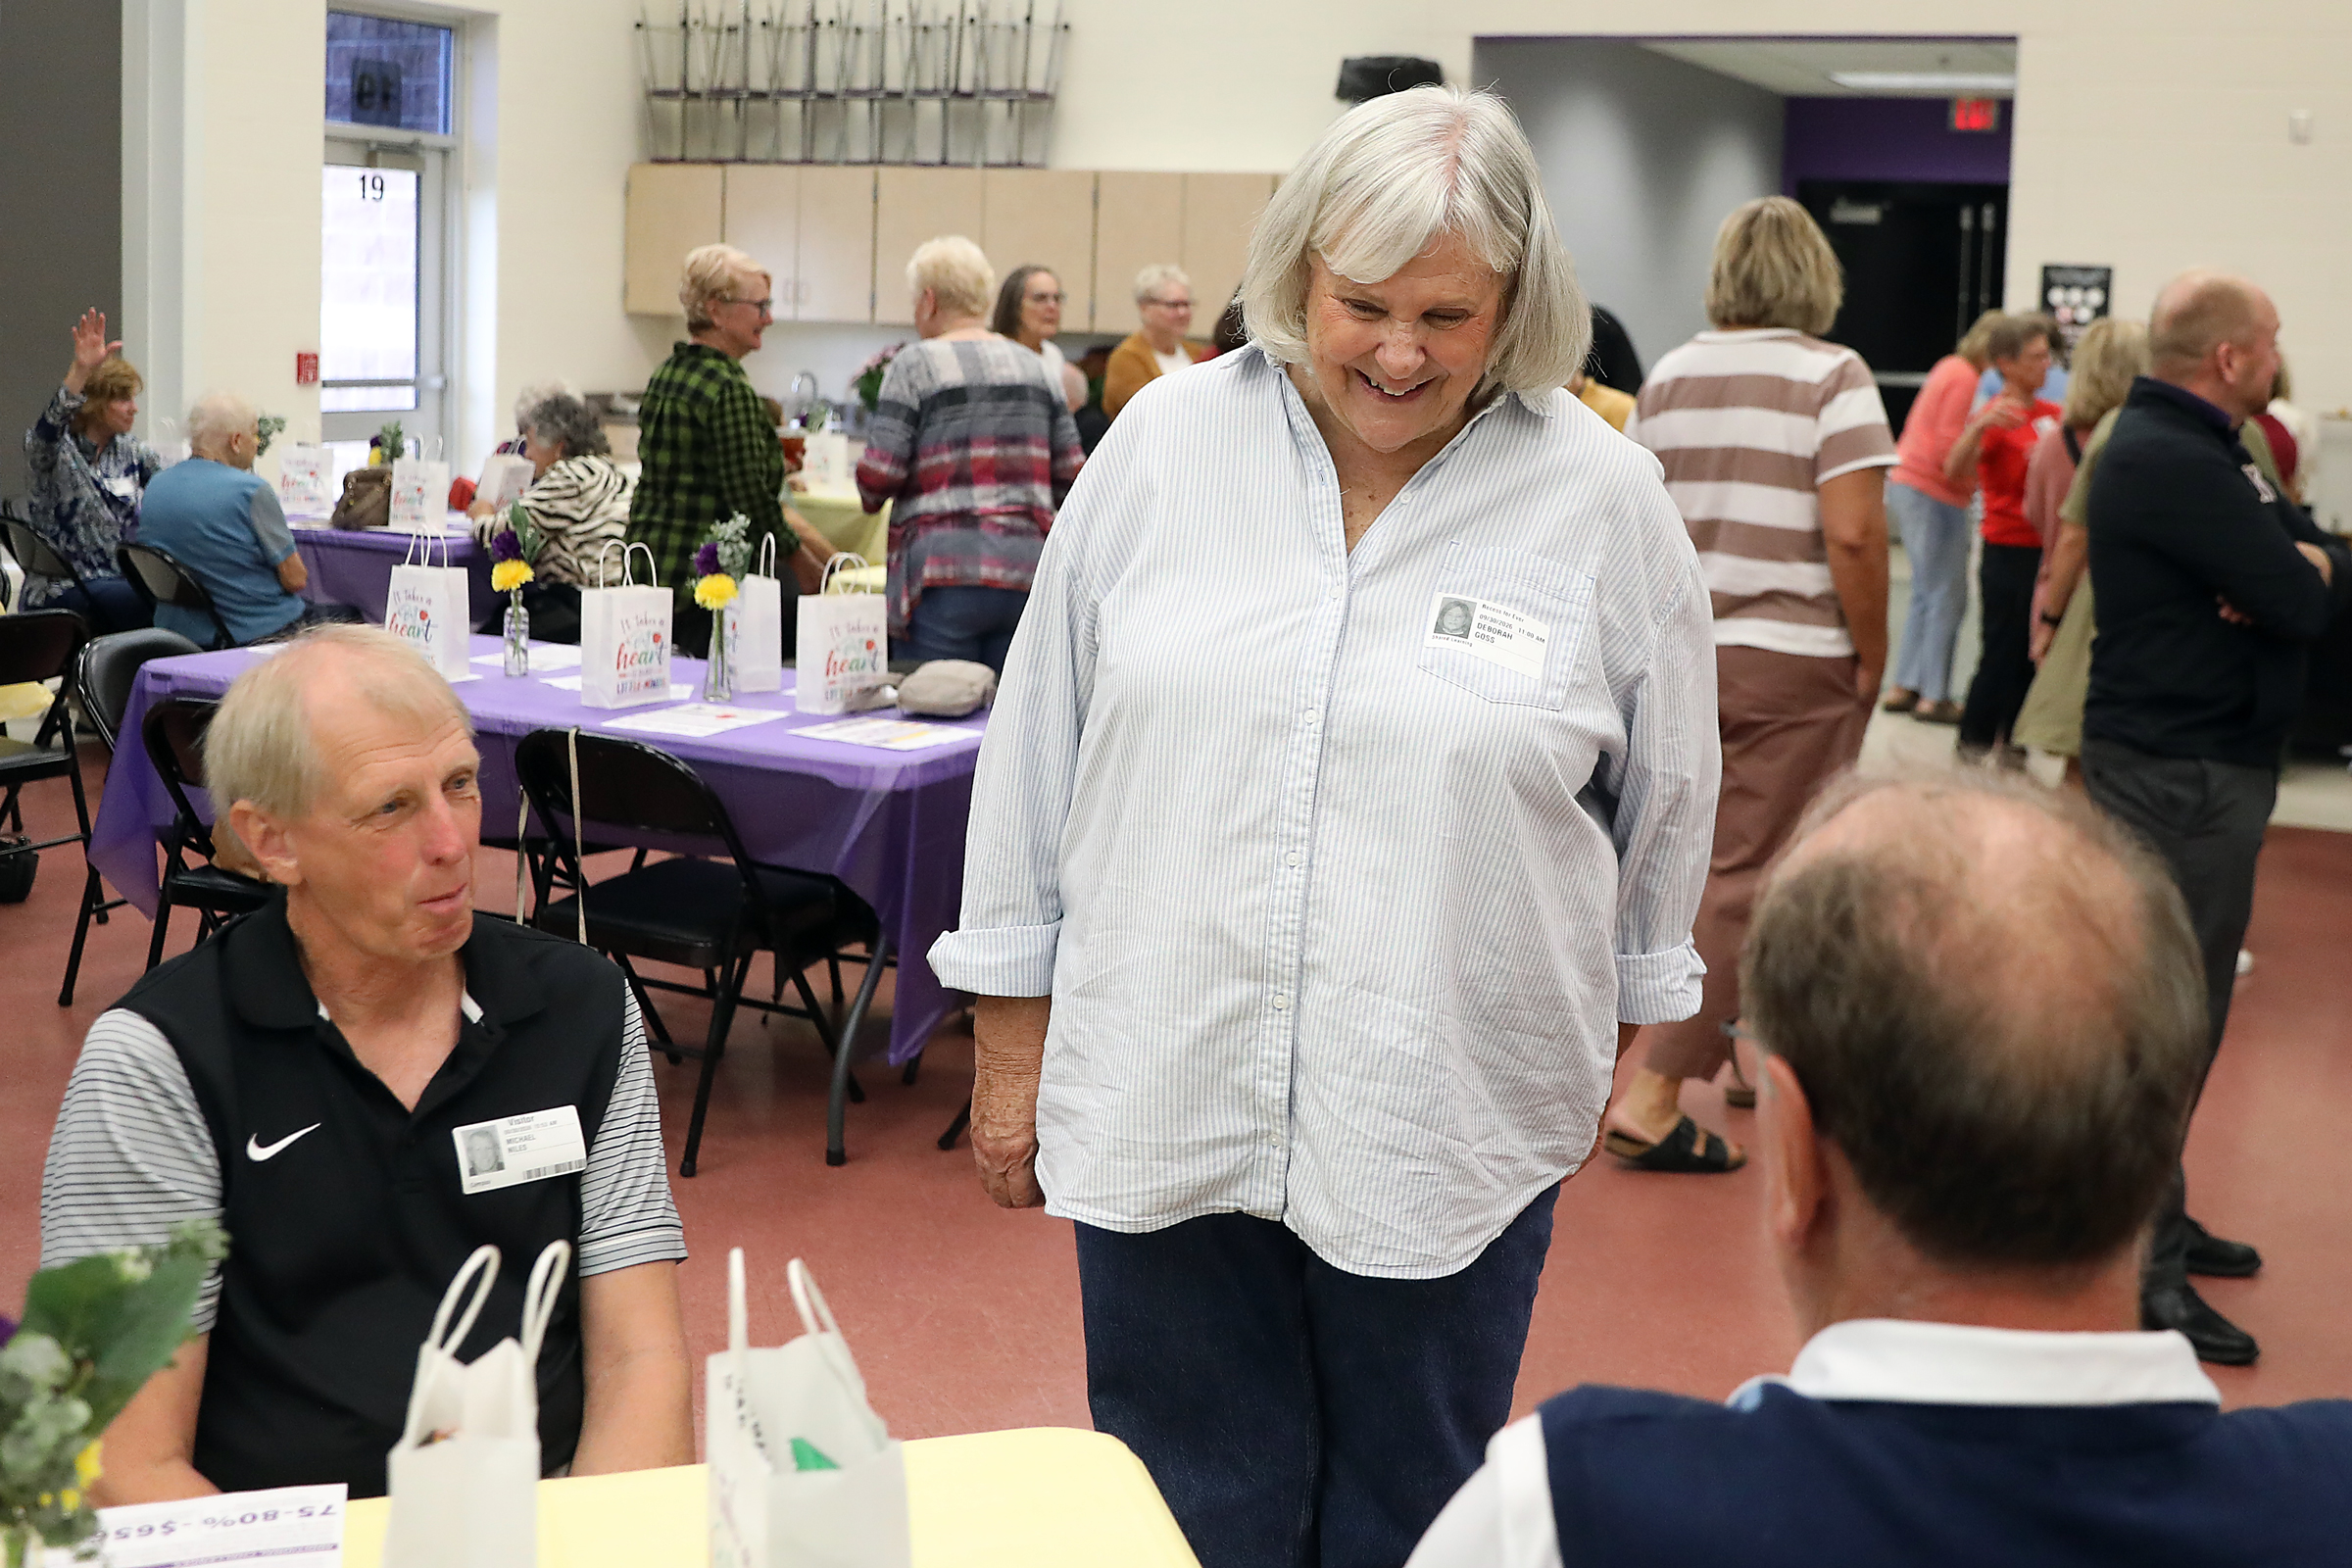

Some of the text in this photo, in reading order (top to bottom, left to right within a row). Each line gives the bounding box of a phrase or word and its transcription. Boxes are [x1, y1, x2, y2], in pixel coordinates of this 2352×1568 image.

[359, 174, 384, 202] 19
[389, 612, 438, 643] heart
[1474, 631, 1495, 644] GOSS
[1477, 622, 1513, 640] DEBORAH
[616, 642, 668, 670] heart
[825, 648, 882, 677] heart
[508, 1115, 534, 1126] Visitor
[506, 1134, 536, 1145] MICHAEL
[202, 1504, 337, 1529] 75-80%
